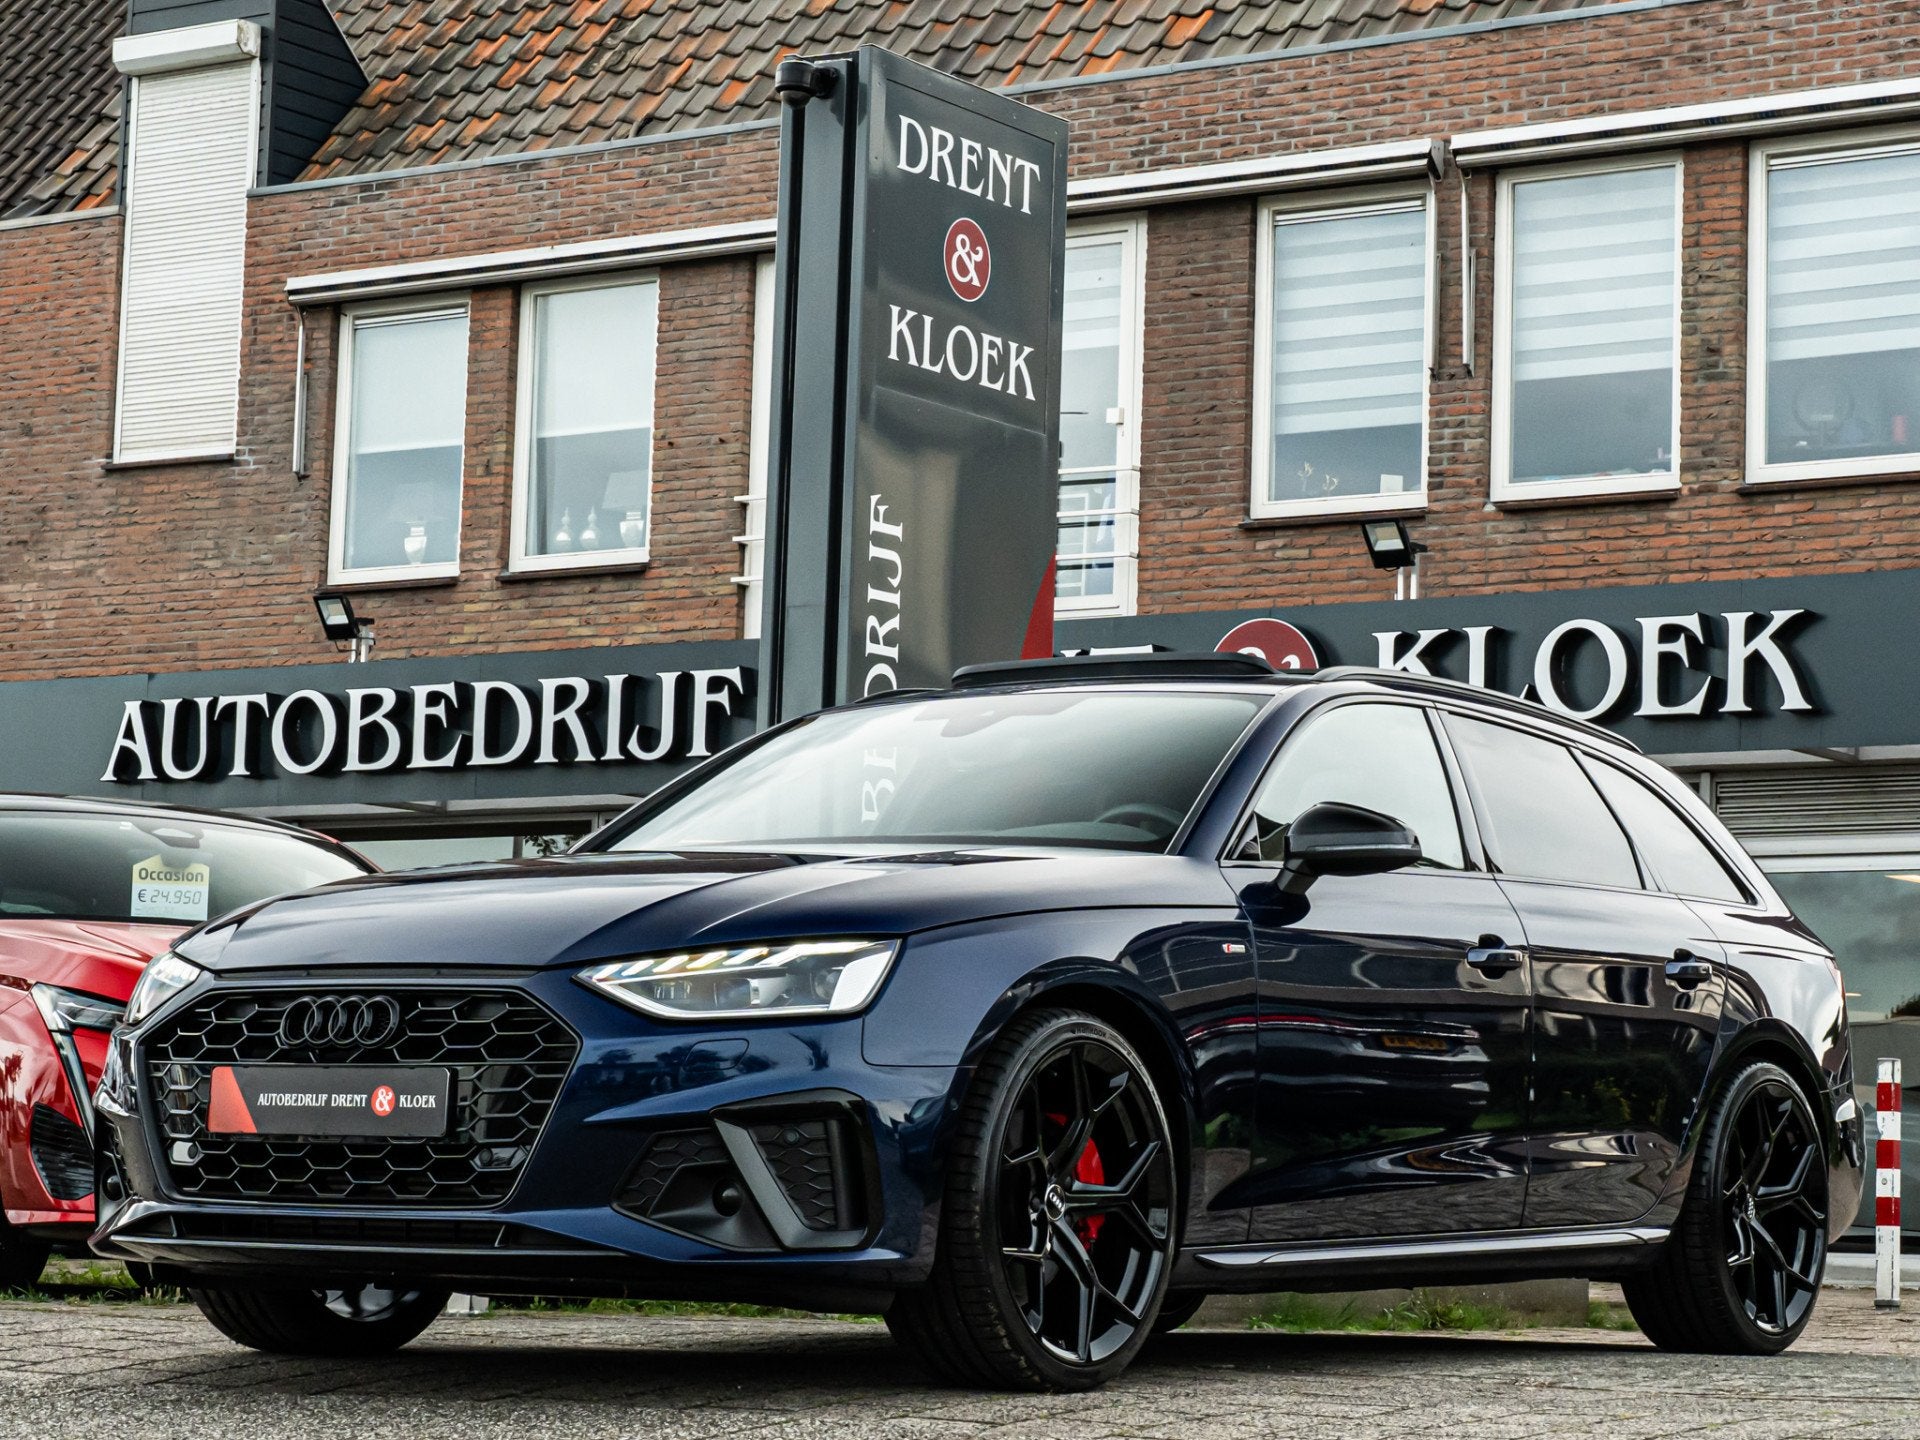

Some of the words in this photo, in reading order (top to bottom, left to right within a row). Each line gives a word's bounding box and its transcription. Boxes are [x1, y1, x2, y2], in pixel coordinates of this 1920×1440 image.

[897, 114, 1041, 215] DRENT
[951, 233, 984, 288] &
[887, 304, 1036, 401] KLOEK
[100, 665, 744, 782] AUTOBEDRIJF
[138, 867, 204, 882] Occasion
[257, 1093, 328, 1106] AUTOBEDRIJF
[331, 1094, 367, 1107] DRENT
[375, 1088, 392, 1111] &
[400, 1095, 436, 1108] KLOEK
